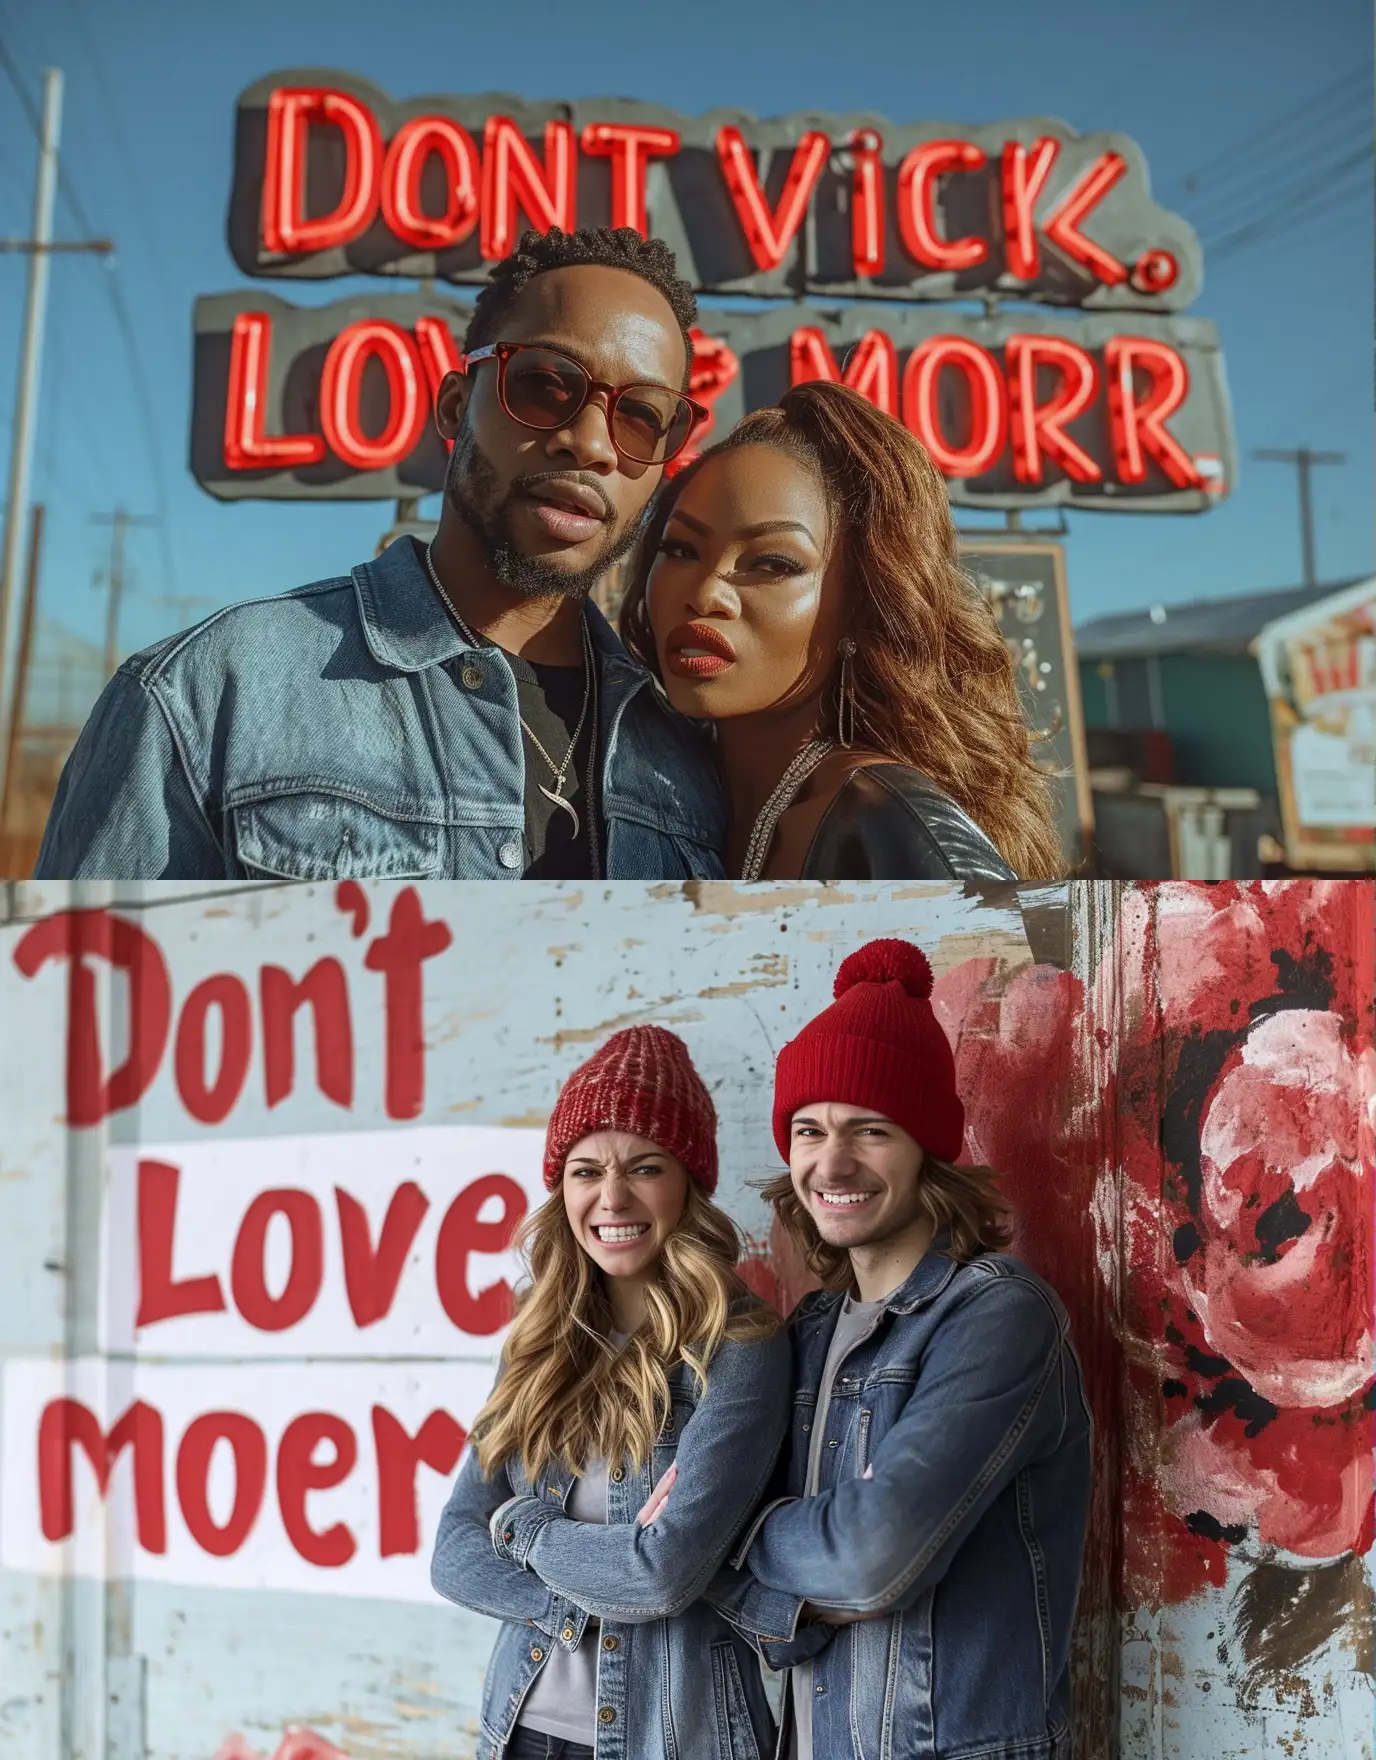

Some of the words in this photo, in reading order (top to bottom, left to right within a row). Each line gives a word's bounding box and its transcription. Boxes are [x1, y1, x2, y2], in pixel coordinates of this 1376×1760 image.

[263, 86, 681, 262] DONT
[13, 880, 453, 1129] Don't
[135, 1158, 529, 1338] Love
